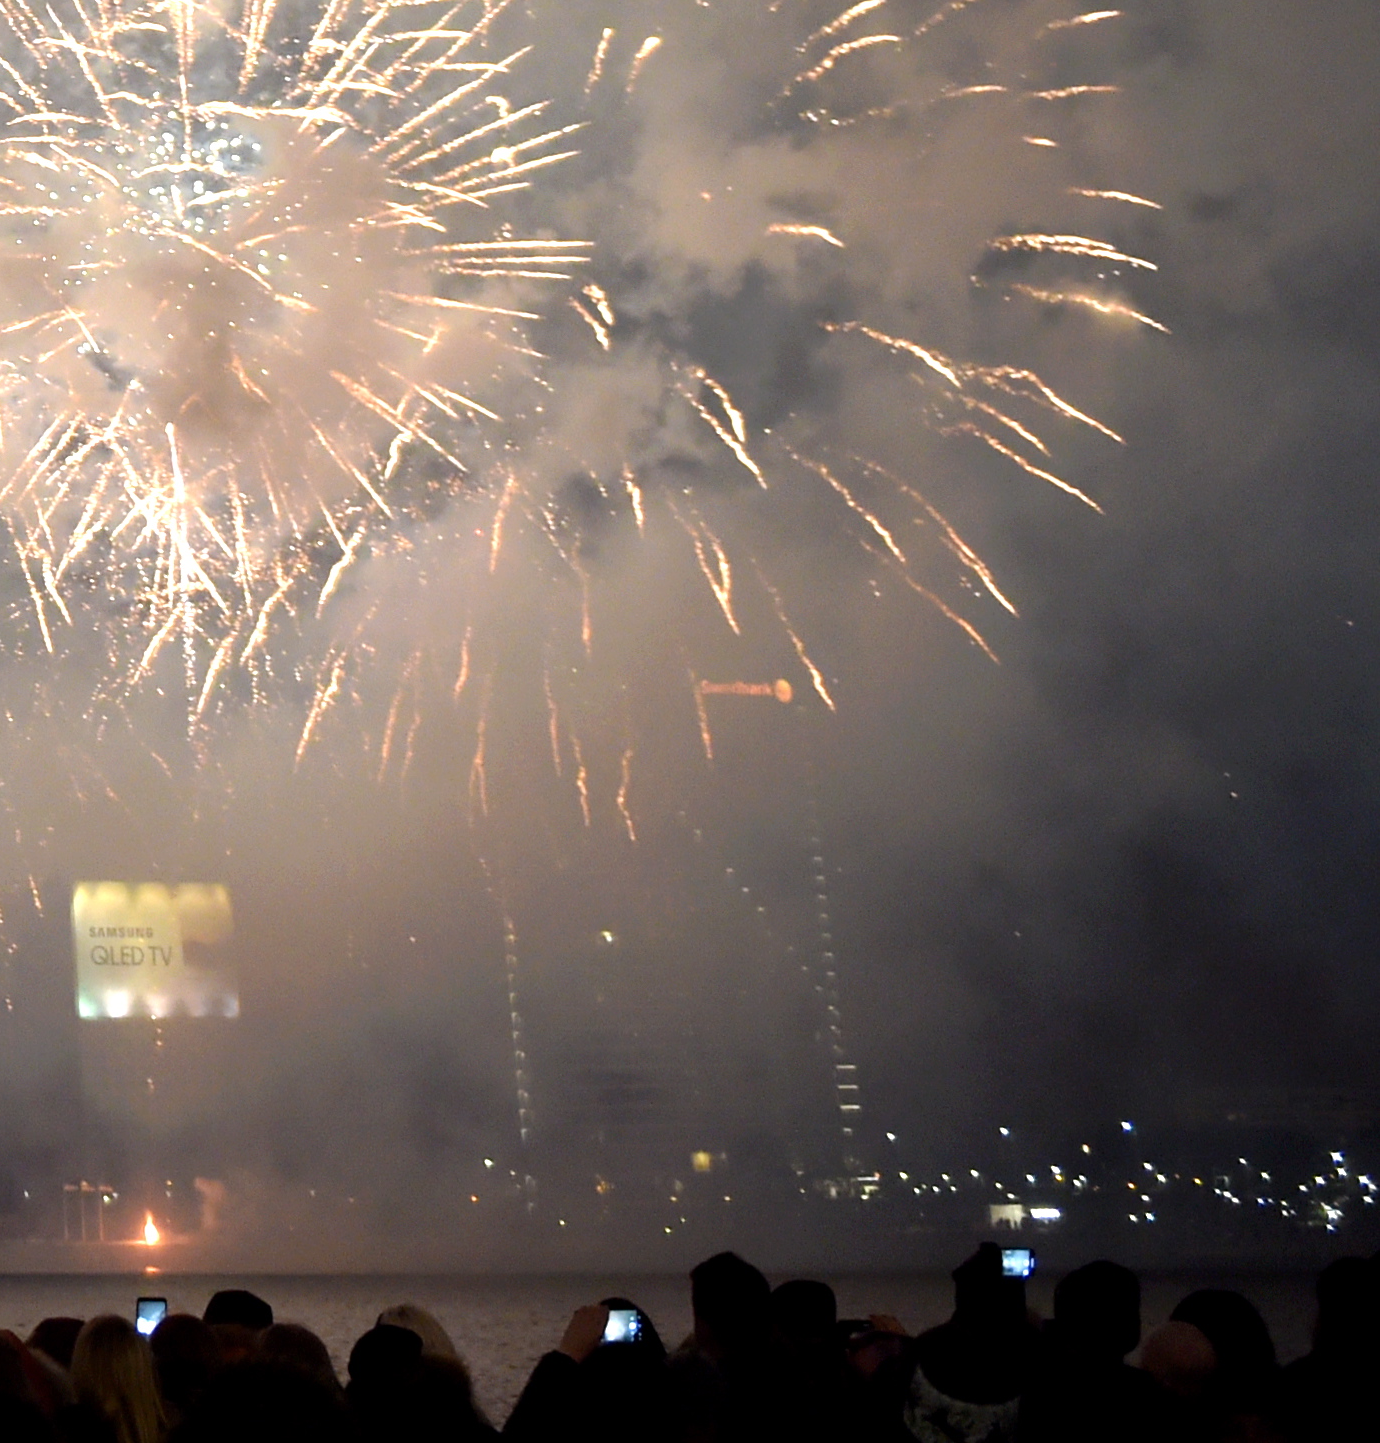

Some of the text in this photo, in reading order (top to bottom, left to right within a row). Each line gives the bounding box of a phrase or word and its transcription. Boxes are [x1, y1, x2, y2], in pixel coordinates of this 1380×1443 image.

[89, 927, 154, 938] SAMSUNG
[91, 945, 173, 966] QLED TV
